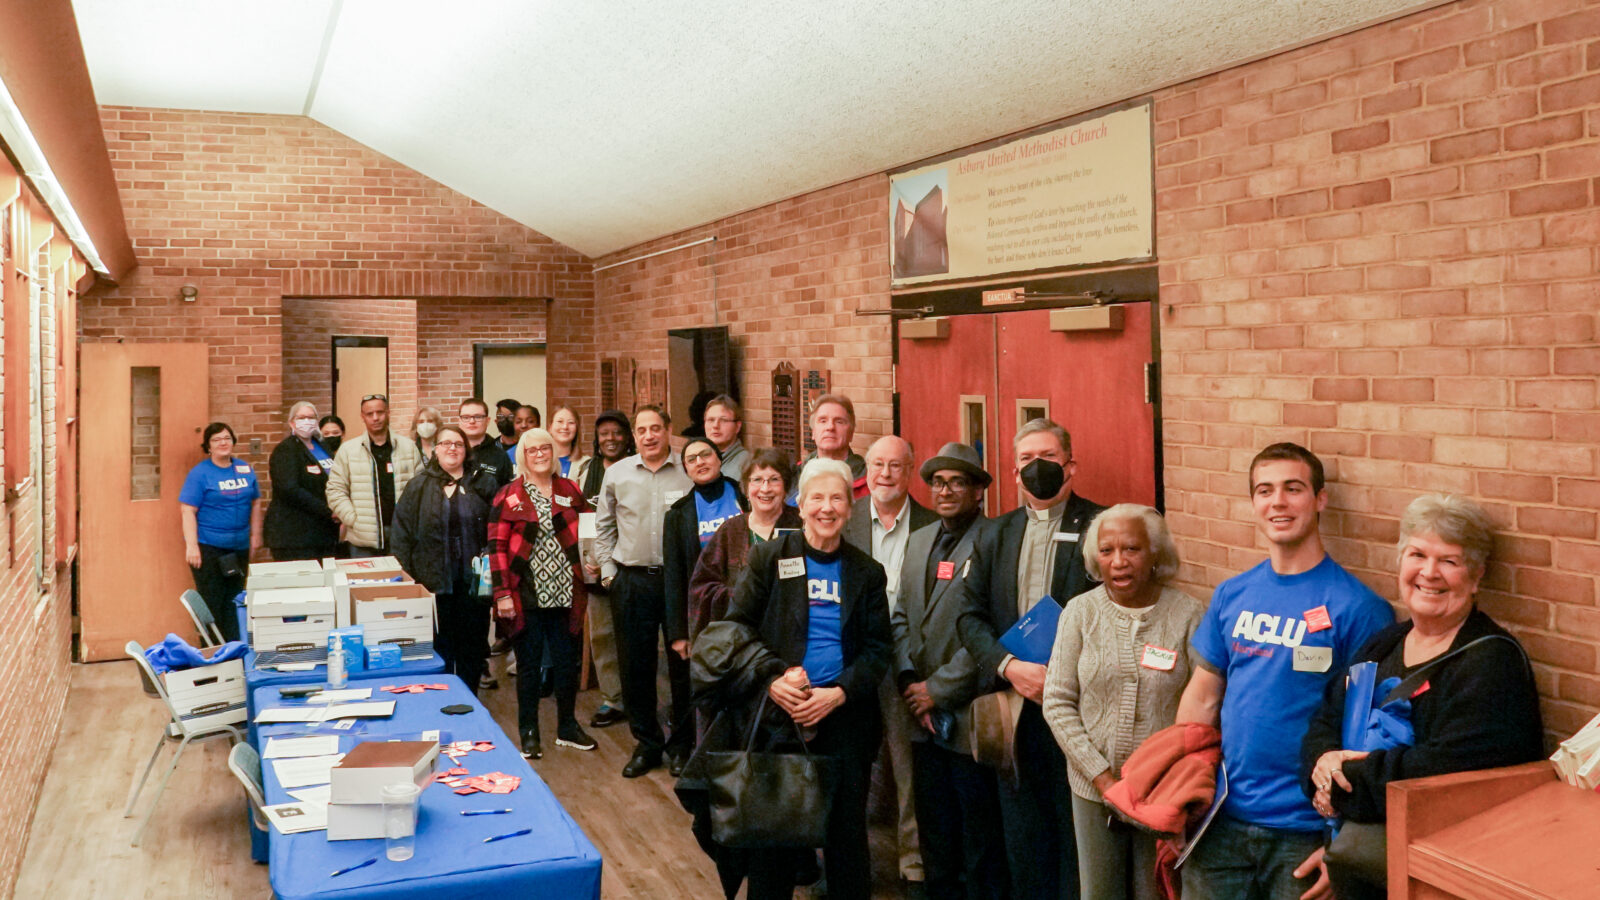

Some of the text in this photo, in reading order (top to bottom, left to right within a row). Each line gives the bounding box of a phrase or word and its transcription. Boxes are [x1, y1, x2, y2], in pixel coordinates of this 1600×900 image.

[956, 159, 985, 176] Asbury
[987, 146, 1017, 168] United
[1018, 133, 1067, 159] Methodist
[1070, 121, 1107, 146] Church
[218, 477, 249, 491] ACLU
[807, 578, 841, 604] CLU
[1231, 610, 1308, 648] ACLU
